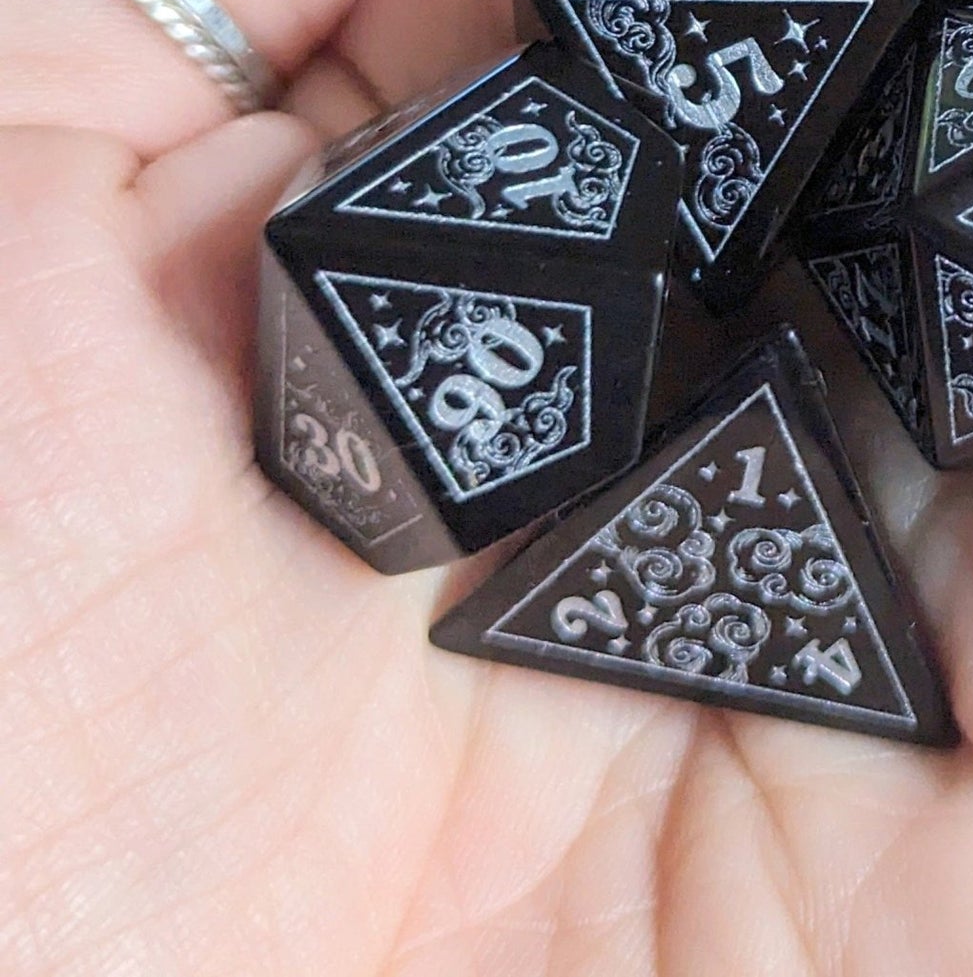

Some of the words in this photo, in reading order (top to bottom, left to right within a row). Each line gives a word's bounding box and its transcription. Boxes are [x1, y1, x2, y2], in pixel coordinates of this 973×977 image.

[668, 38, 784, 127] 5
[490, 124, 579, 210] 10
[429, 318, 544, 442] 90
[297, 414, 382, 492] 30
[727, 446, 766, 508] 1
[550, 589, 629, 641] 2
[793, 637, 862, 696] 4
